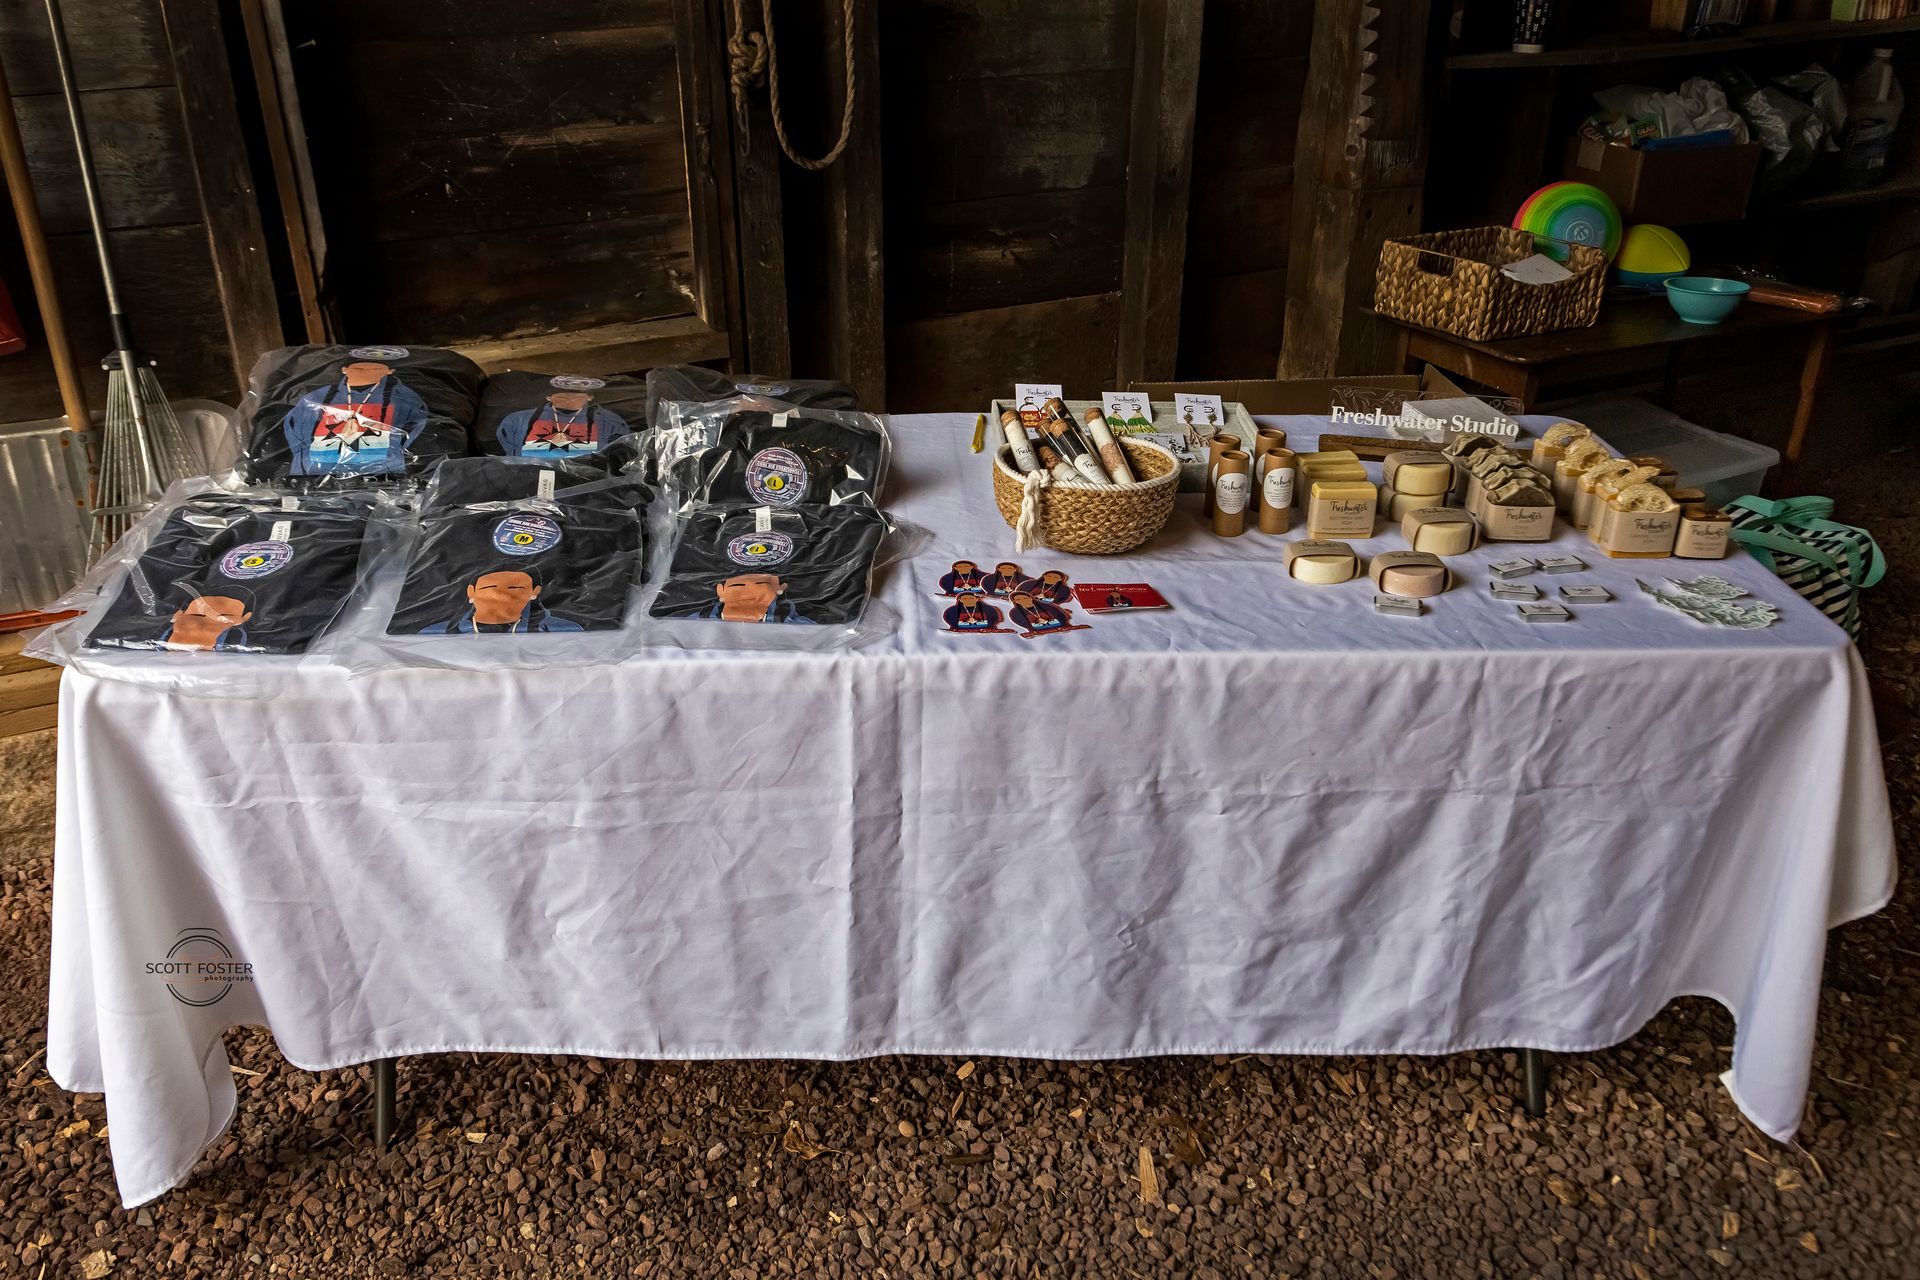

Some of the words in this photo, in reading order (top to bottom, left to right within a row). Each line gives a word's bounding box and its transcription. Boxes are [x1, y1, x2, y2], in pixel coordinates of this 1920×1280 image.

[1330, 405, 1448, 432] Freshwater
[1450, 414, 1520, 438] Studio
[518, 535, 529, 543] M
